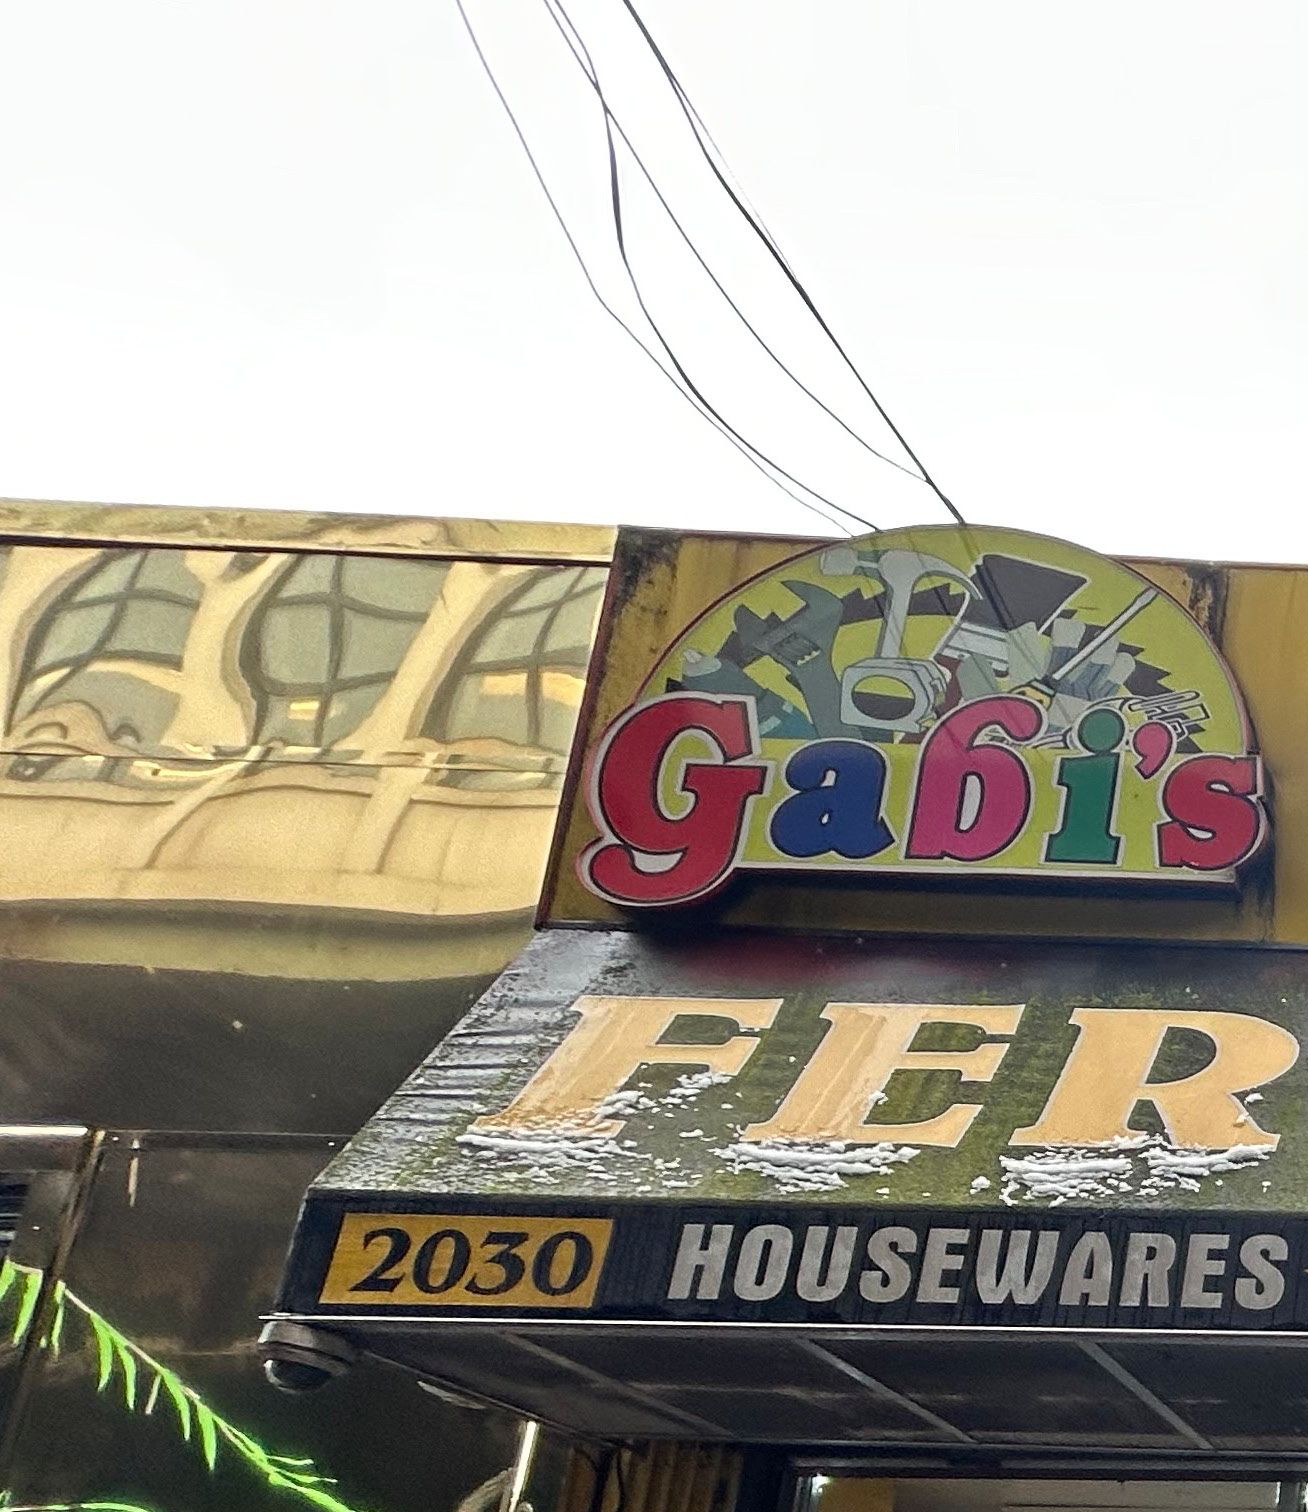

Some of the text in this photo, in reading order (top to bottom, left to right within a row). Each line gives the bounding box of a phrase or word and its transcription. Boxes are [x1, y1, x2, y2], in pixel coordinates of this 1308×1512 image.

[578, 690, 1271, 908] Gabi's
[349, 1226, 595, 1298] 2030
[667, 1222, 1289, 1311] HOUSEWARES
